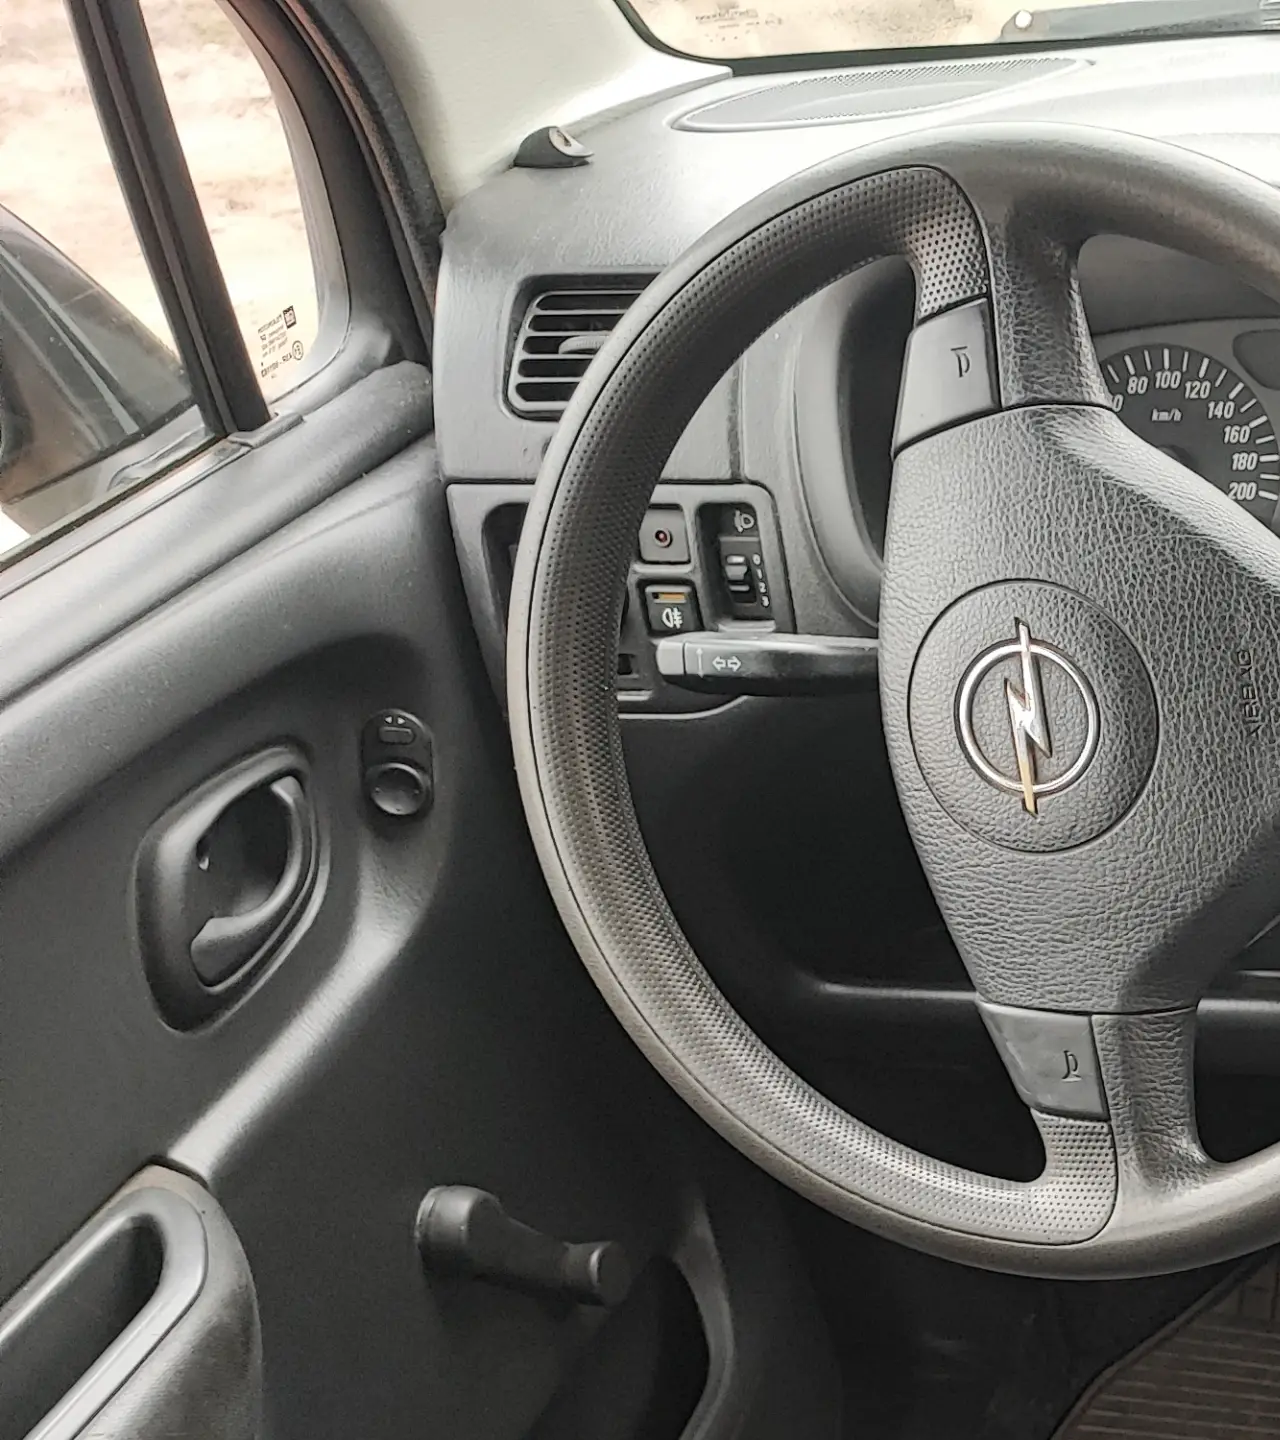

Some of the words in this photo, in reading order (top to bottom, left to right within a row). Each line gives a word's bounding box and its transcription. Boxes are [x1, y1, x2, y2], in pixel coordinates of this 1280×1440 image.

[1127, 376, 1148, 395] 80
[1155, 370, 1182, 389] 100
[1185, 380, 1211, 399] 120
[1112, 394, 1124, 412] 0
[1208, 401, 1235, 419] 140
[1151, 408, 1182, 422] km/h
[1223, 425, 1250, 444] 160
[1232, 452, 1258, 471] 180
[1228, 482, 1257, 500] 200
